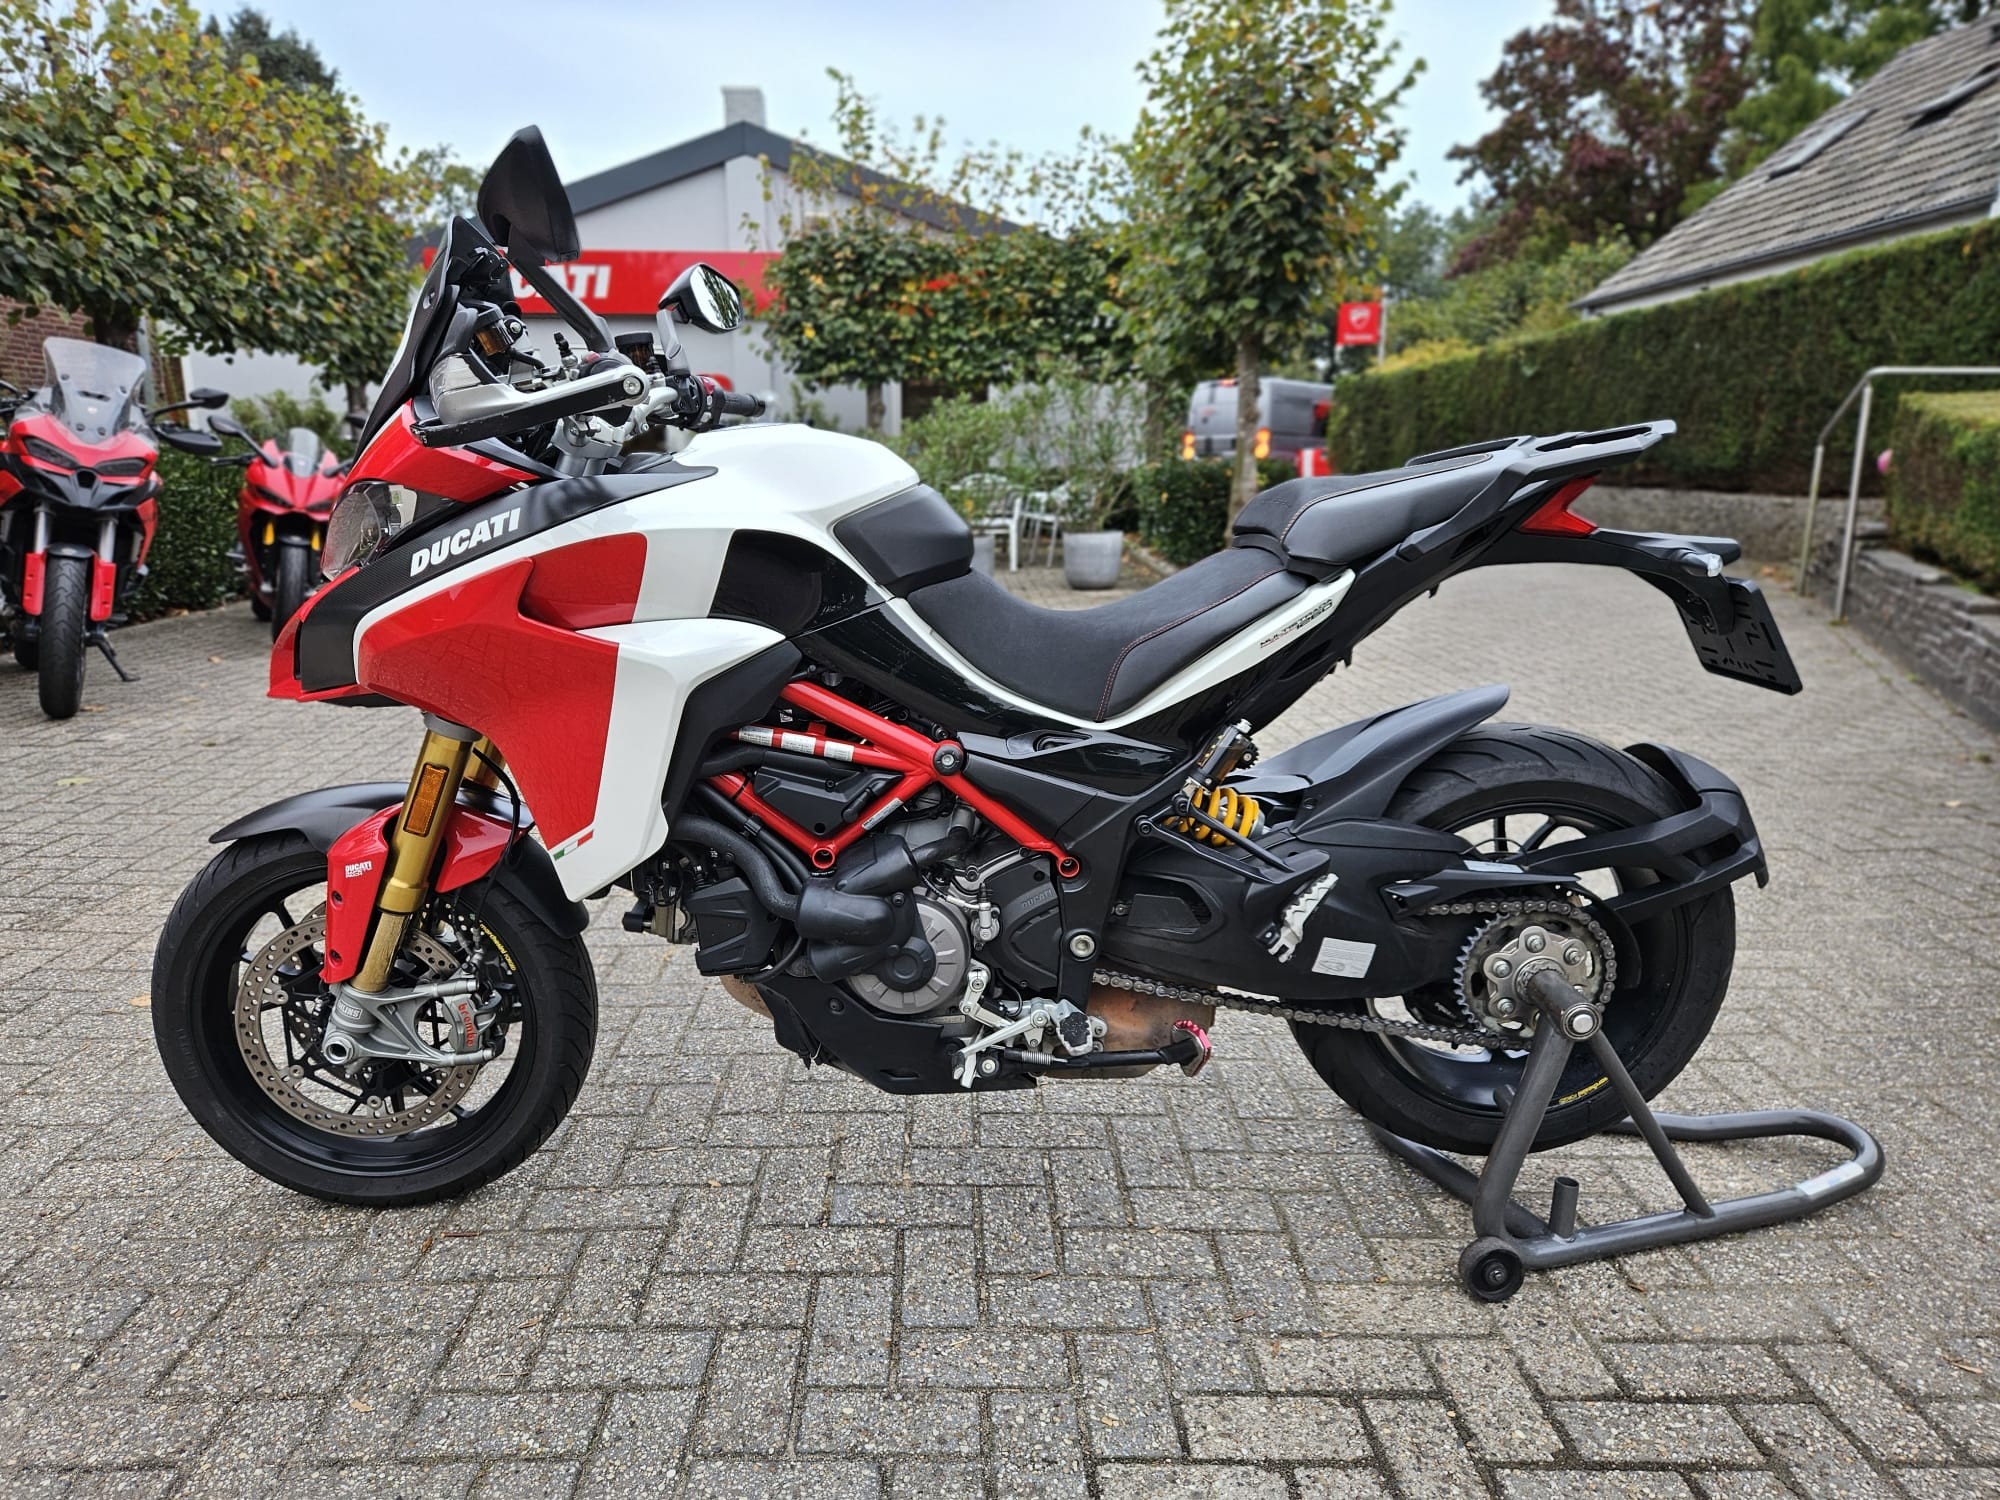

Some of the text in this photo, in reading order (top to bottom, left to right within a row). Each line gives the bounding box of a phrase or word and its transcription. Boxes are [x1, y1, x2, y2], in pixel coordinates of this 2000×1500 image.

[509, 264, 612, 299] CATI
[410, 507, 521, 577] DUCATI
[345, 861, 372, 872] DUCATI
[1023, 889, 1052, 908] DUCATI
[458, 1003, 476, 1047] brembo
